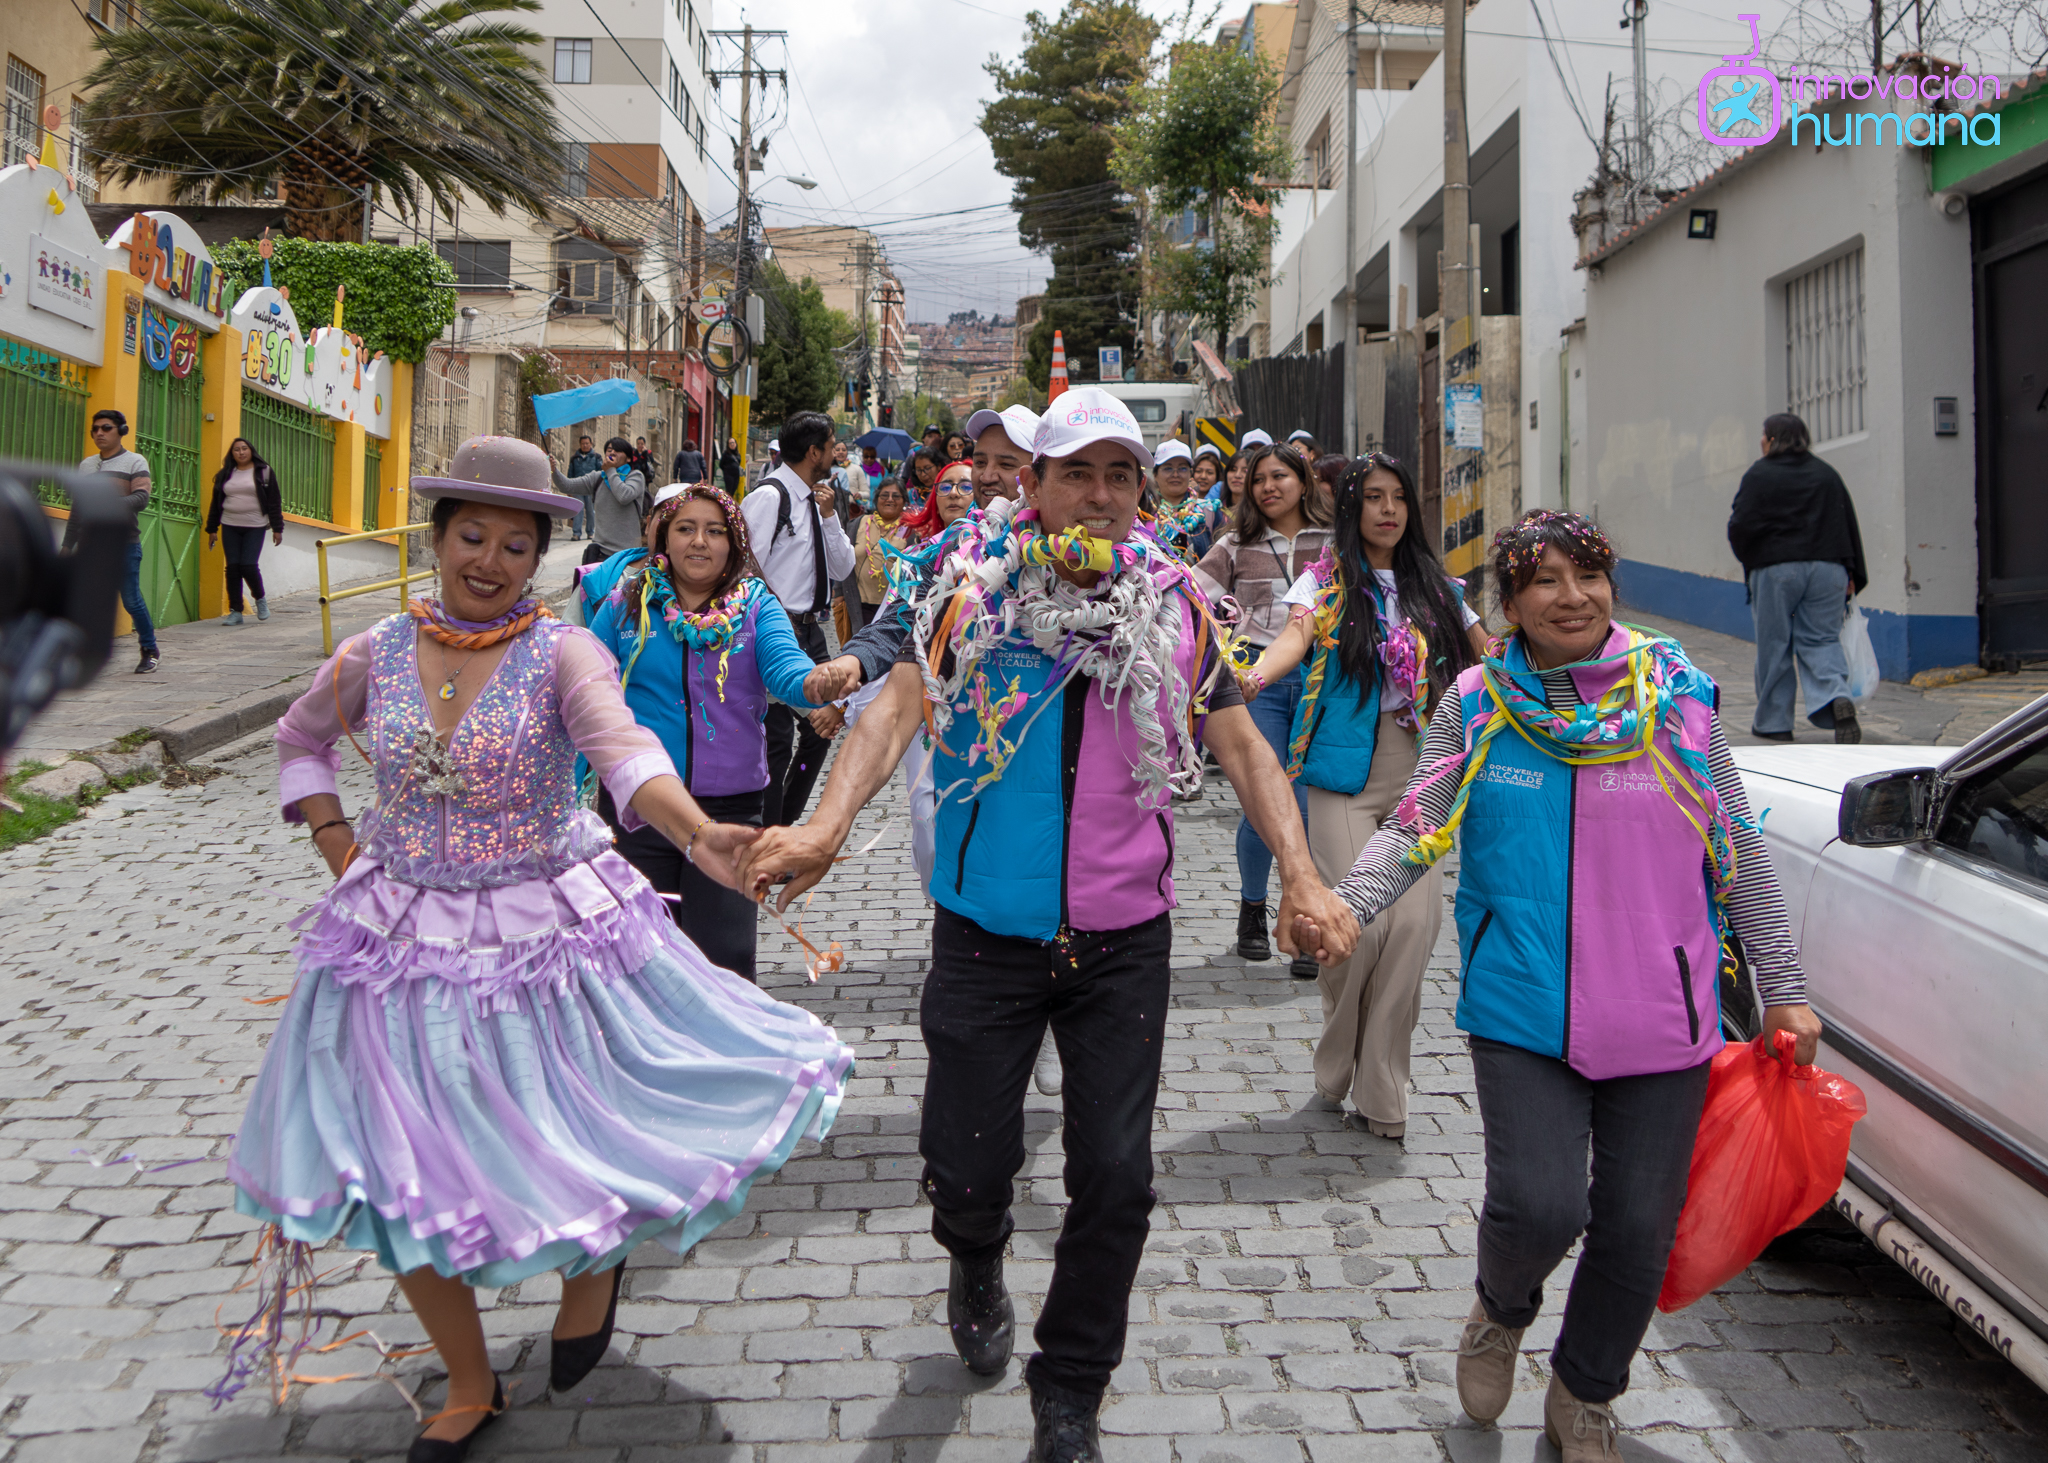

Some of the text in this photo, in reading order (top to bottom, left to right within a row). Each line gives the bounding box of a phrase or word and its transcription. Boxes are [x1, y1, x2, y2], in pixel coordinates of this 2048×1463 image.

[266, 330, 292, 390] 30
[1107, 351, 1114, 362] E
[1090, 414, 1134, 434] humana
[1488, 770, 1543, 785] ALCALDE
[1489, 763, 1544, 778] DOCKWEILER
[1890, 1239, 1950, 1305] TWIN
